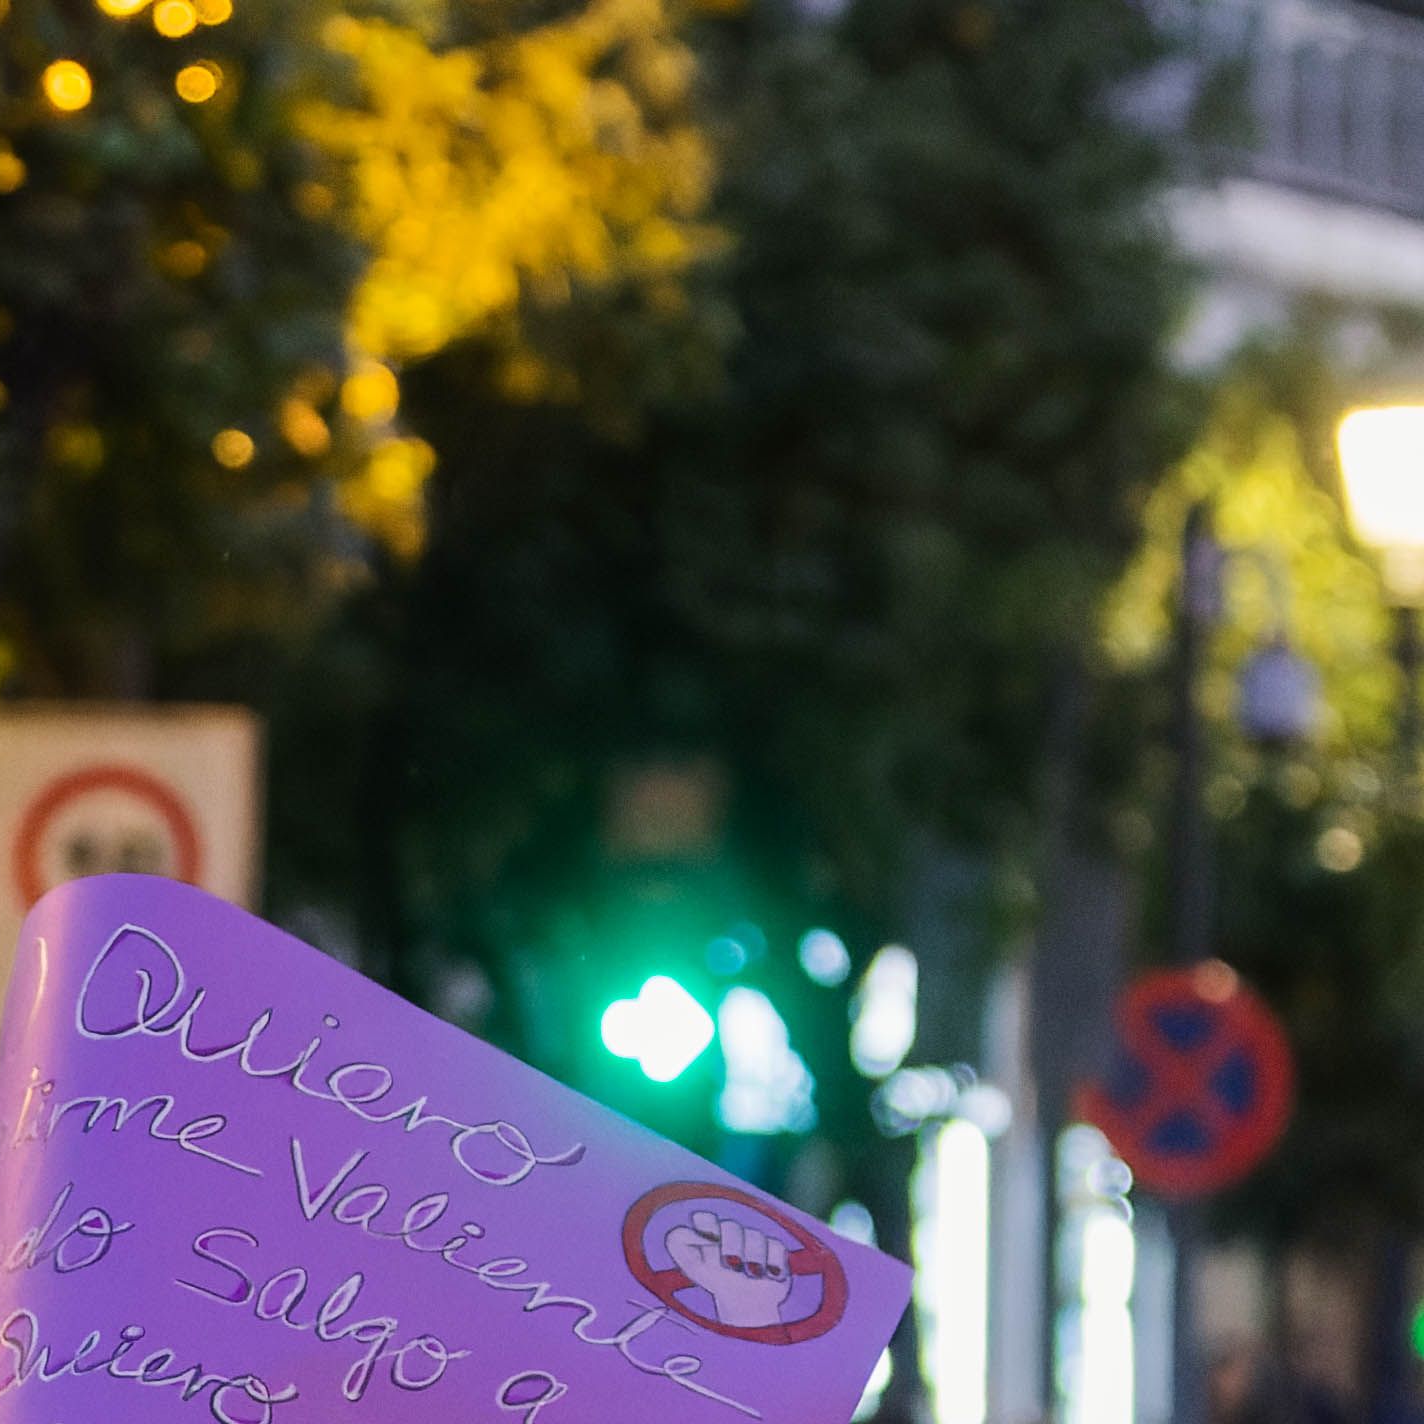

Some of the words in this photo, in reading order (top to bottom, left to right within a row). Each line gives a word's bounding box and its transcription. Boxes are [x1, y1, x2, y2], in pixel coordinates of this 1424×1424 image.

[77, 923, 586, 1186] Quiero
[175, 1228, 471, 1401] Salgo
[290, 1137, 762, 1420] Valiente
